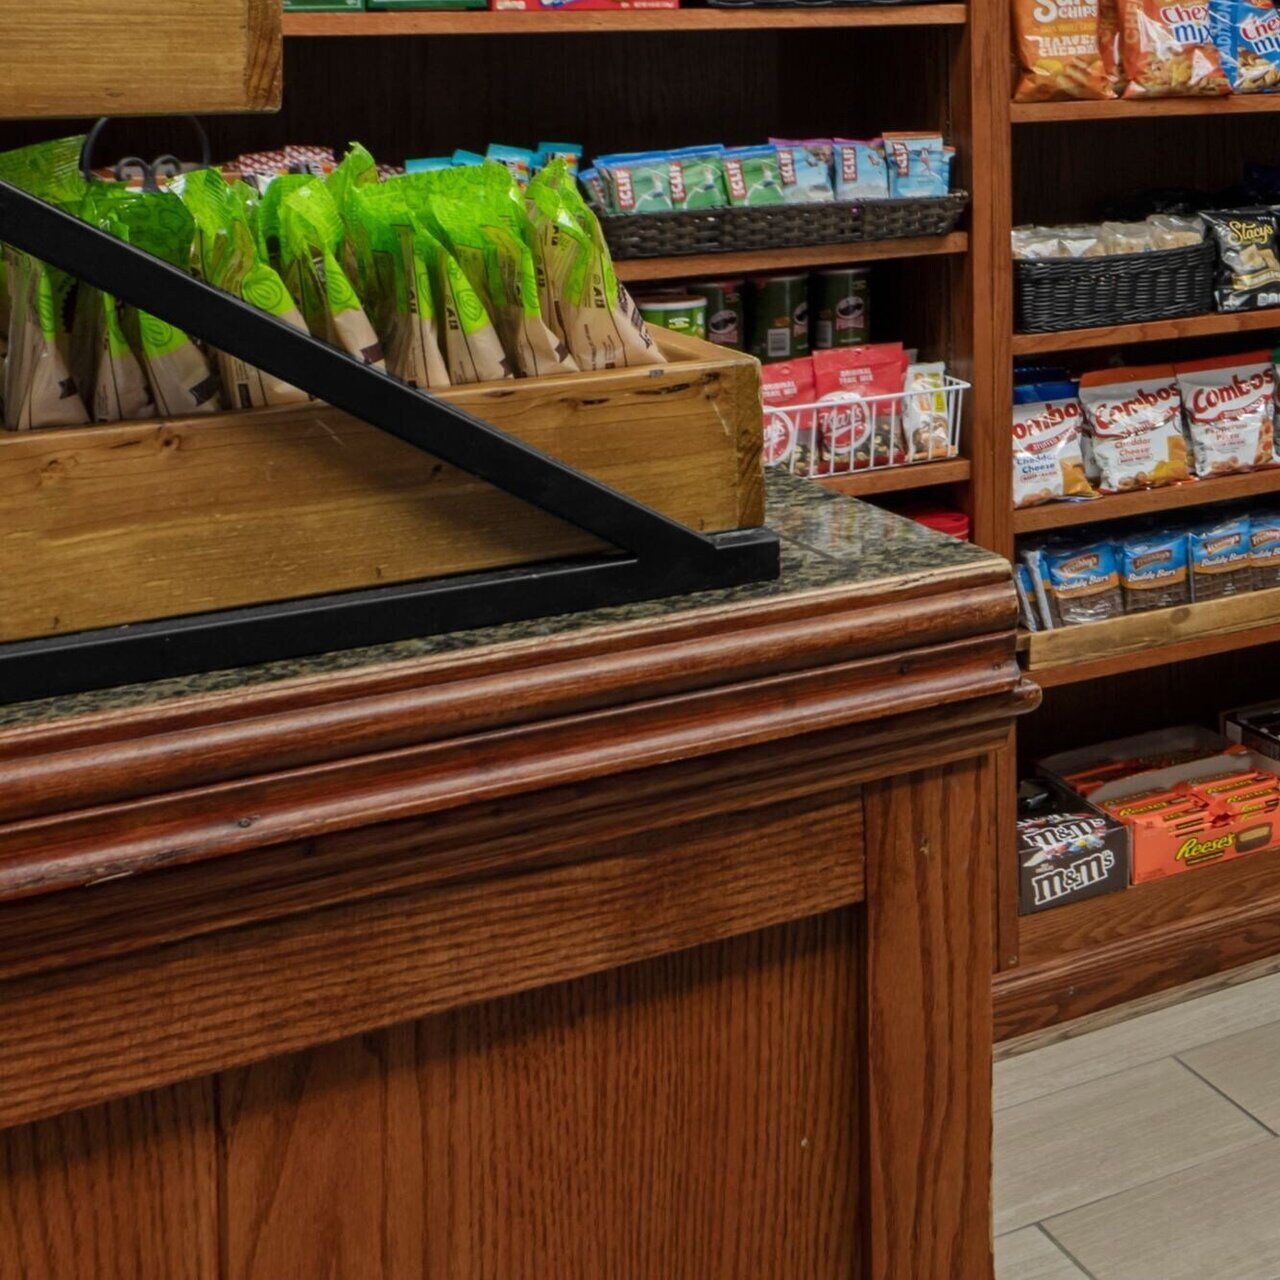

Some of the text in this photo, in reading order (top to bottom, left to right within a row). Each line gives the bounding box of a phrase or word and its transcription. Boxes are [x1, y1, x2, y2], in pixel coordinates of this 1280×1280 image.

[1228, 221, 1273, 245] Stacy's
[1193, 367, 1274, 413] Combos
[1095, 381, 1181, 429] Combos
[1158, 568, 1177, 578] Bars
[1201, 556, 1228, 567] Buddy
[1176, 833, 1236, 861] Reese's
